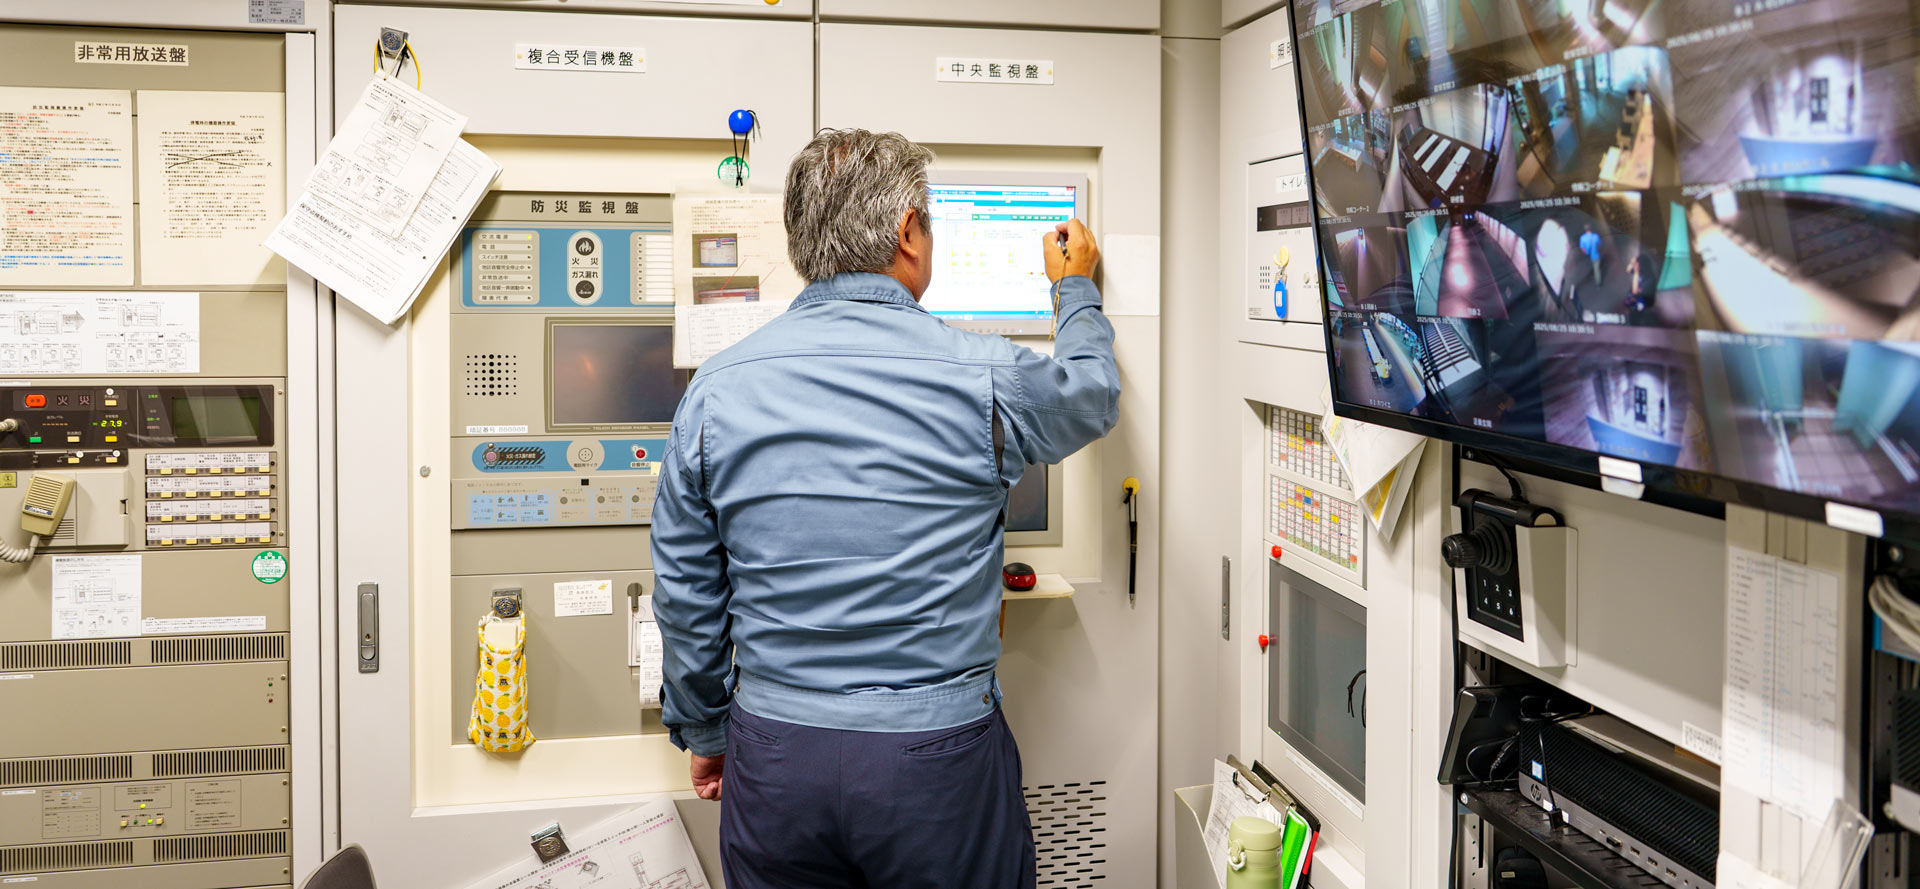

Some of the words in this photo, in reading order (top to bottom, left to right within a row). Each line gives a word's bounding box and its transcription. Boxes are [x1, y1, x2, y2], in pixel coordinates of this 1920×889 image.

[78, 45, 186, 63] 非常用放送盤
[528, 48, 633, 66] 複合受信機盤
[951, 62, 1039, 79] 中央監視盤
[531, 199, 639, 215] 防災監視盤
[571, 257, 599, 265] 火災
[571, 271, 599, 279] ガス漏れ
[57, 395, 90, 406] 火災
[1483, 579, 1487, 587] 1
[1495, 584, 1500, 592] 2
[1508, 589, 1513, 597] 3
[1483, 597, 1489, 605] 4
[1496, 602, 1501, 610] 5
[1509, 607, 1514, 616] 6
